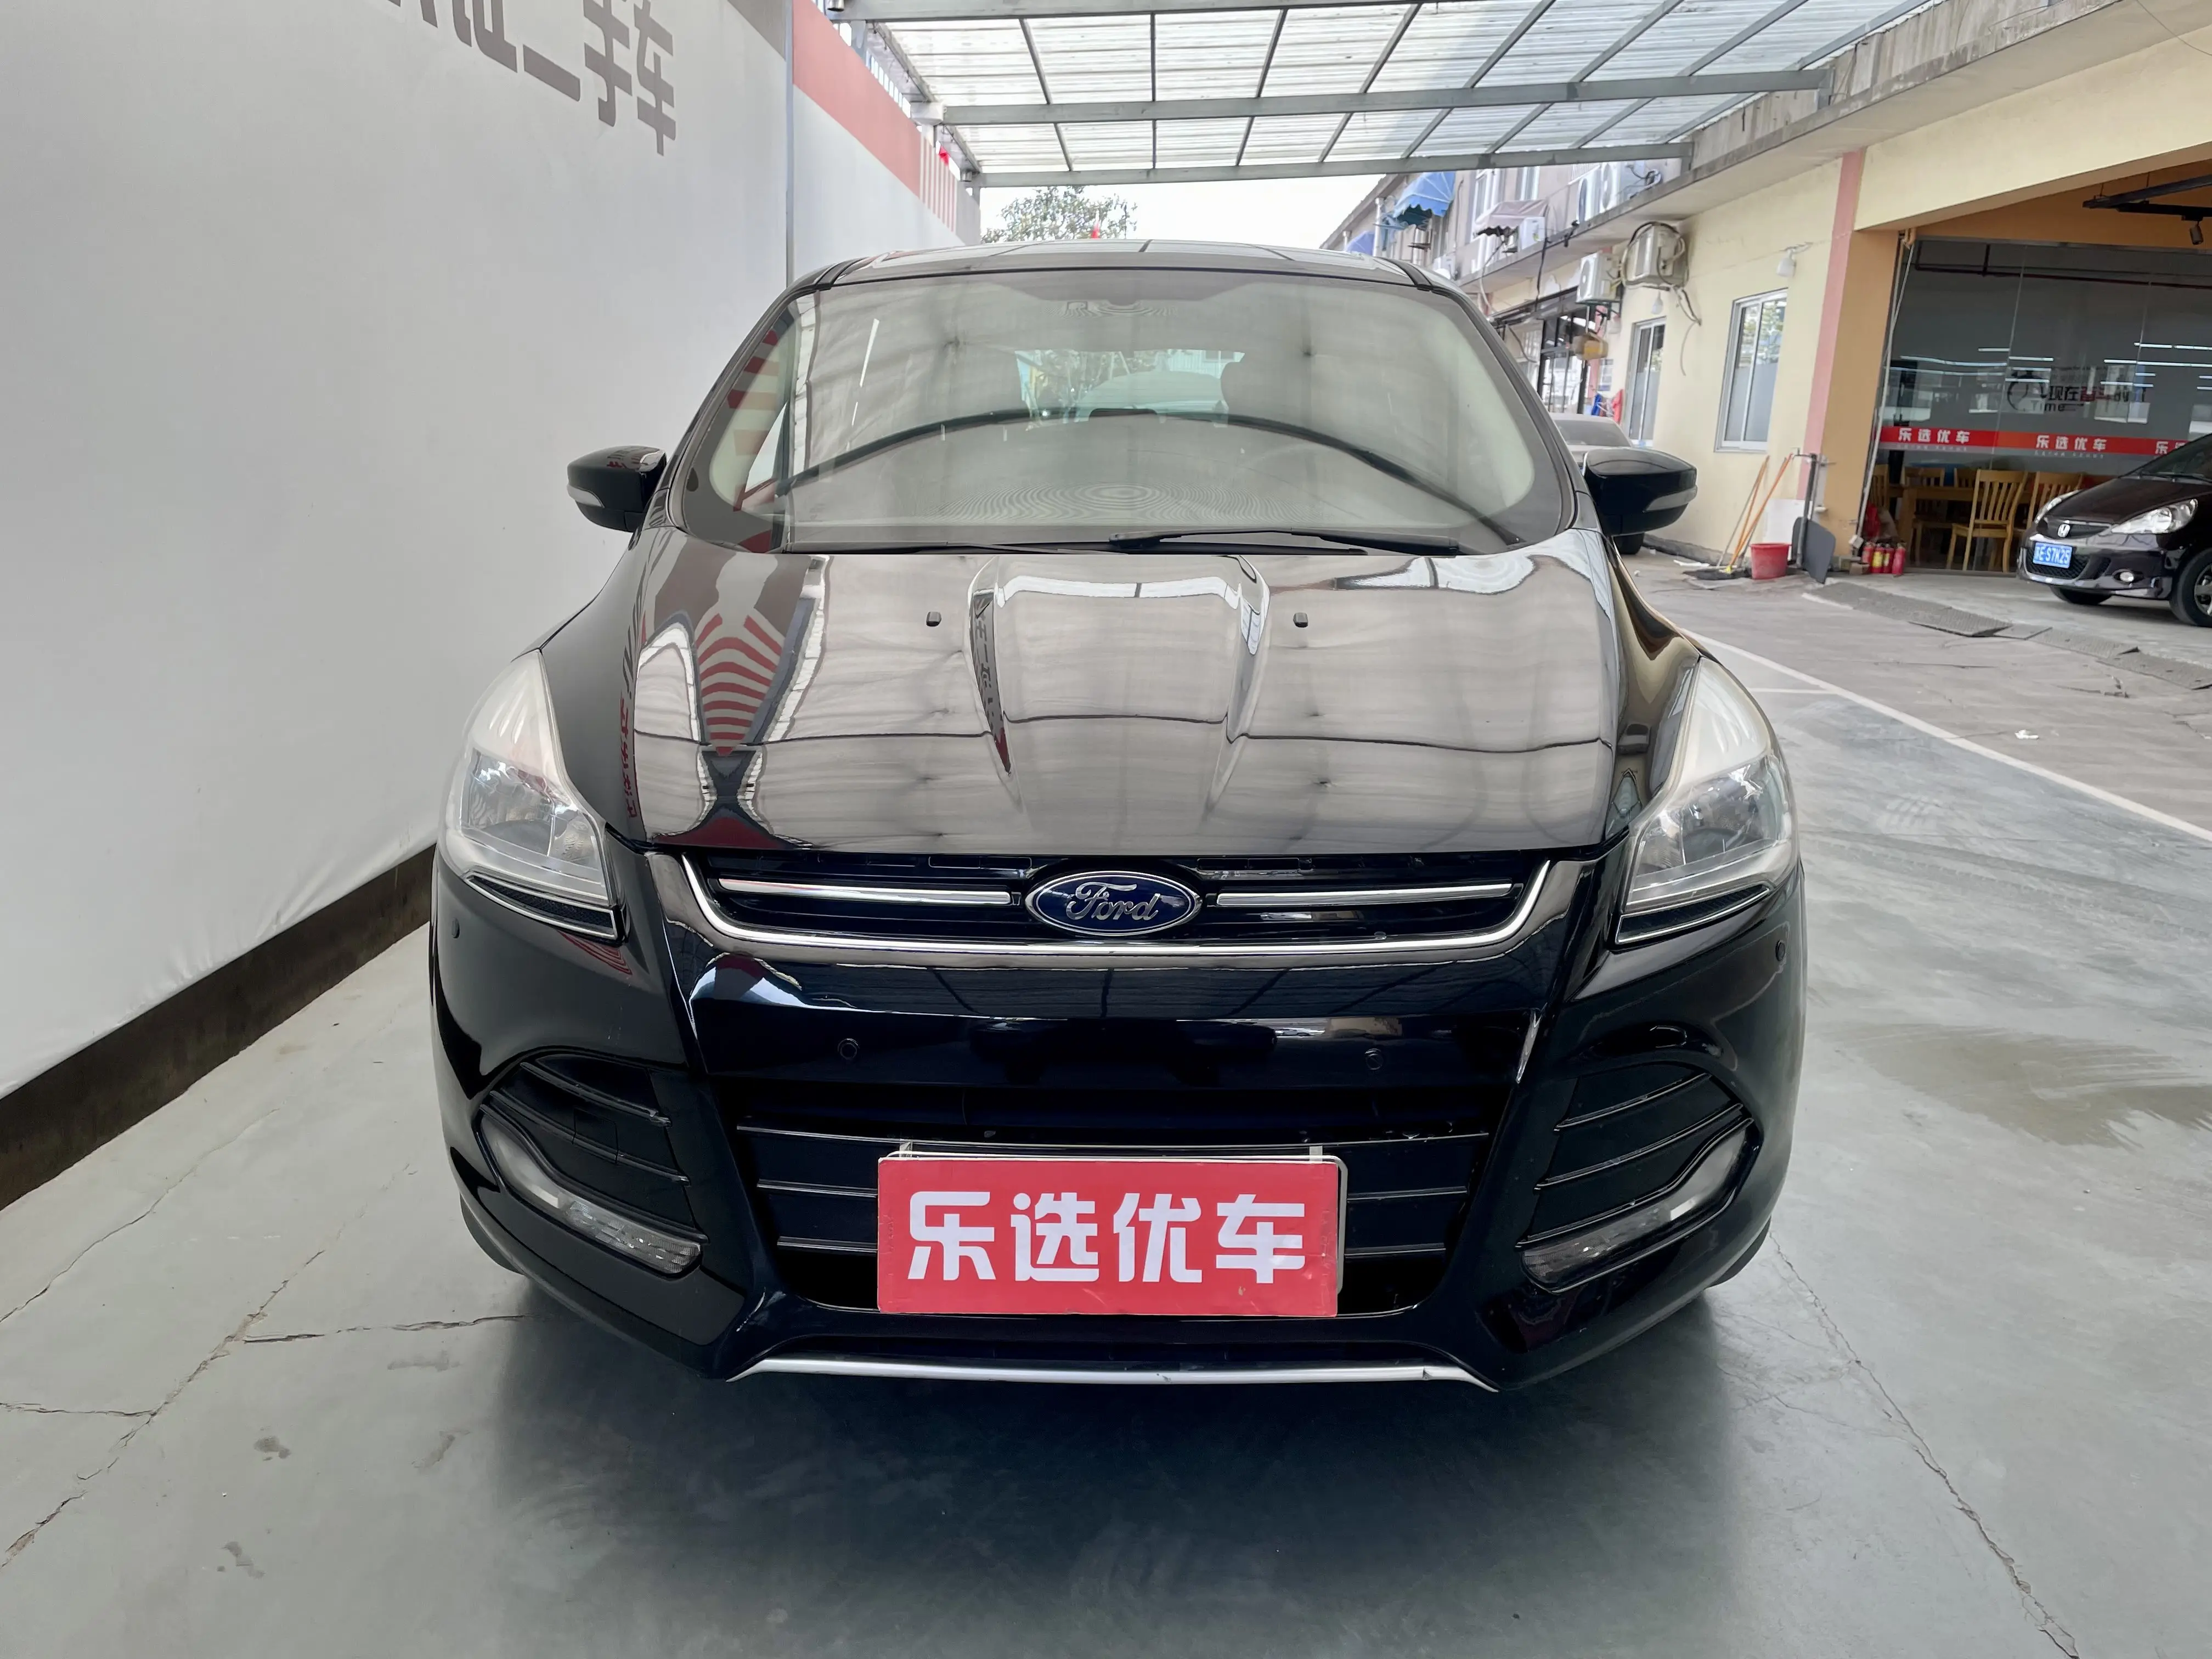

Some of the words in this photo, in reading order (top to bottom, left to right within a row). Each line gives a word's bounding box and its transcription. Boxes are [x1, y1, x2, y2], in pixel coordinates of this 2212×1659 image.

[1898, 427, 1971, 444] 乐选优车
[2036, 435, 2107, 452] 乐选优车
[1066, 882, 1161, 920] Ford
[907, 1190, 1306, 1284] 乐选优车
